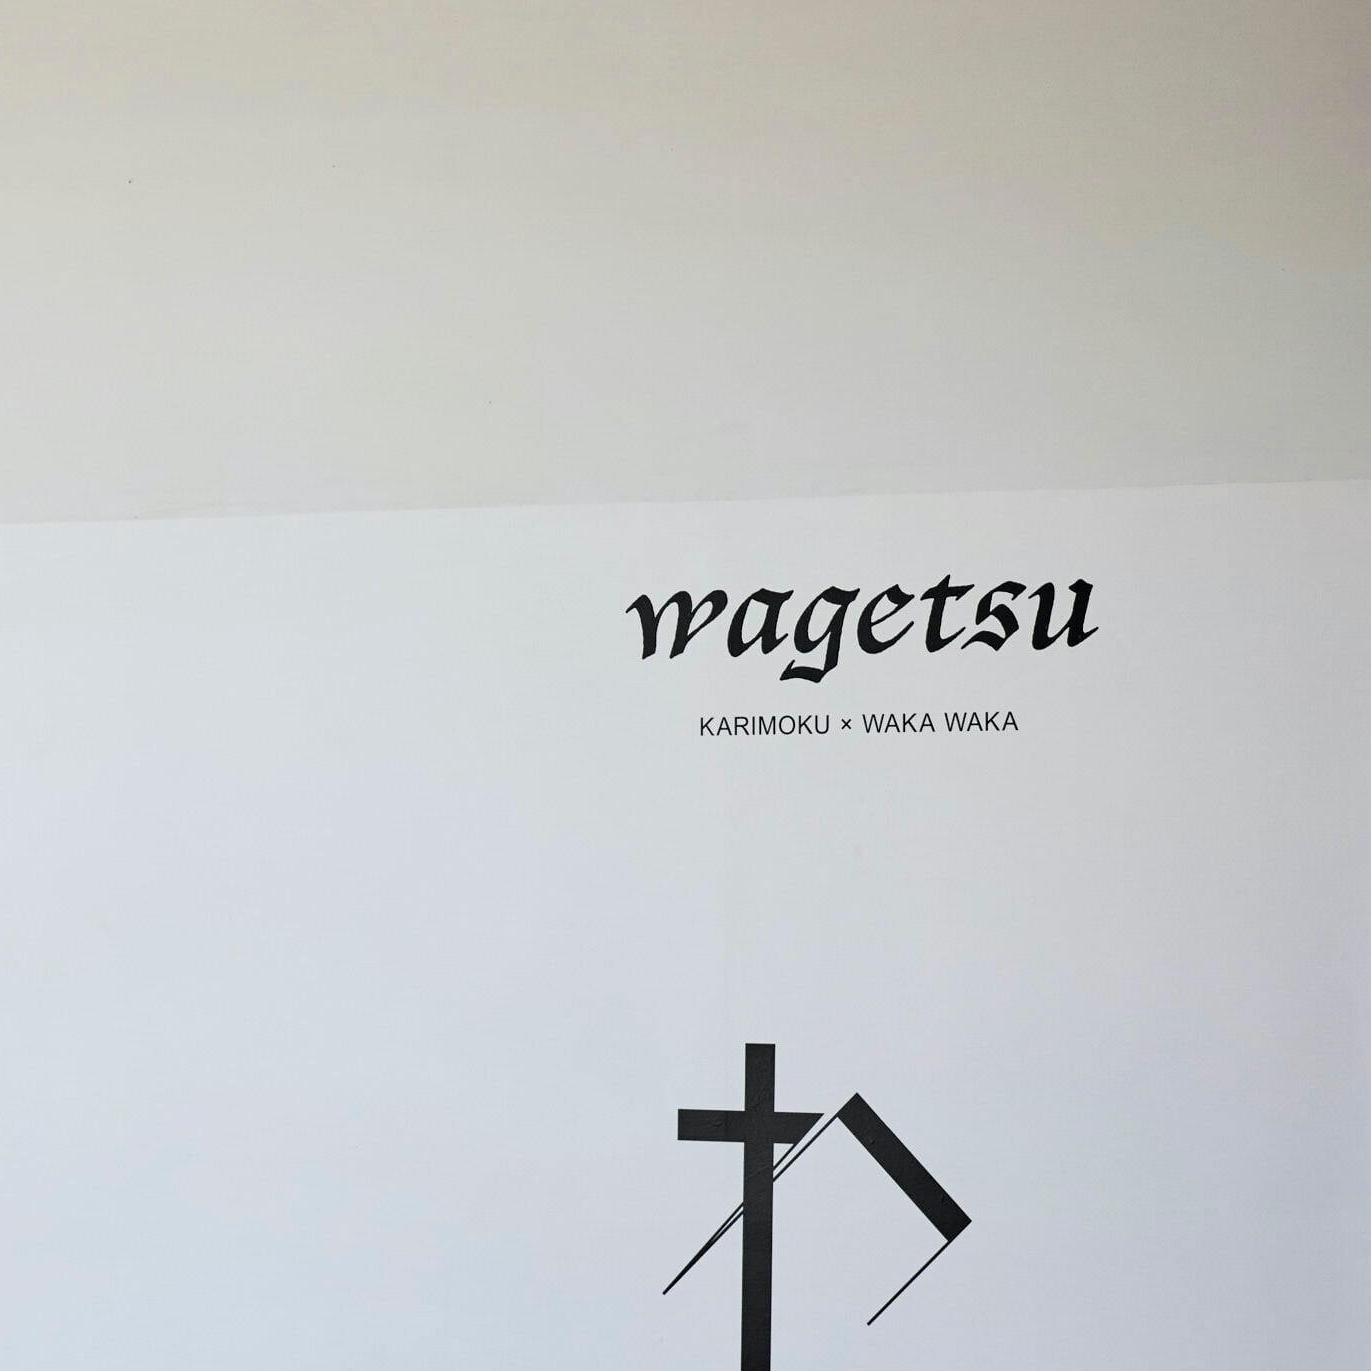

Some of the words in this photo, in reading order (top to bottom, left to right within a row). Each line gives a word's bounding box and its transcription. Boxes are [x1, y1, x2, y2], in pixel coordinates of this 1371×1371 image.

[625, 574, 1099, 684] wagetsu
[699, 714, 830, 737] KARIMOKU
[861, 712, 936, 734] WAKA
[943, 710, 1020, 733] WAKA
